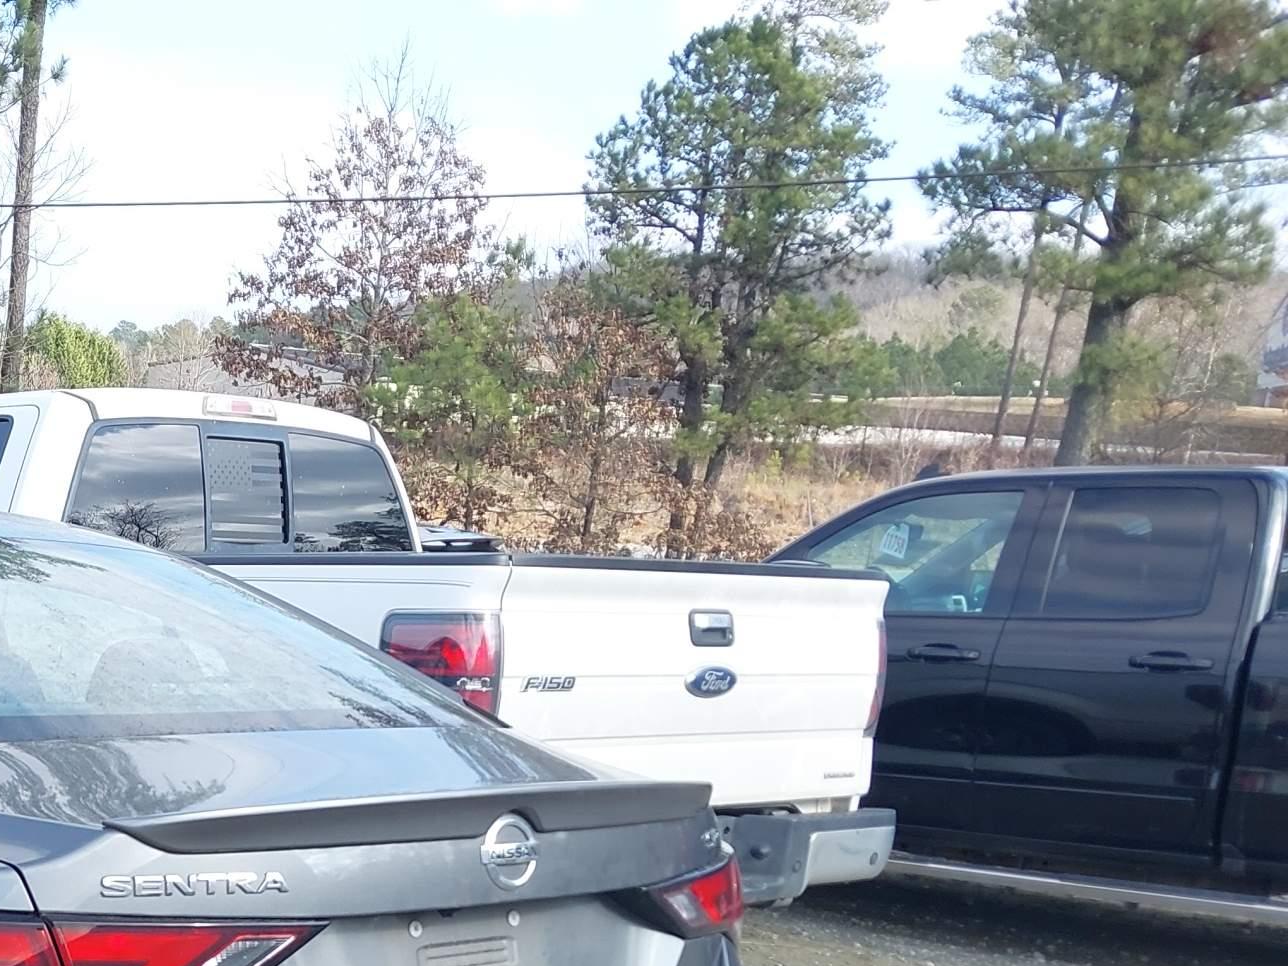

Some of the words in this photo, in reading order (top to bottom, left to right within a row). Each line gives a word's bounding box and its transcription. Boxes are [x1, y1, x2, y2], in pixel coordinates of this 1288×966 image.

[520, 676, 576, 692] F-150
[489, 845, 537, 860] NISSAN
[101, 871, 290, 898] SENTRA
